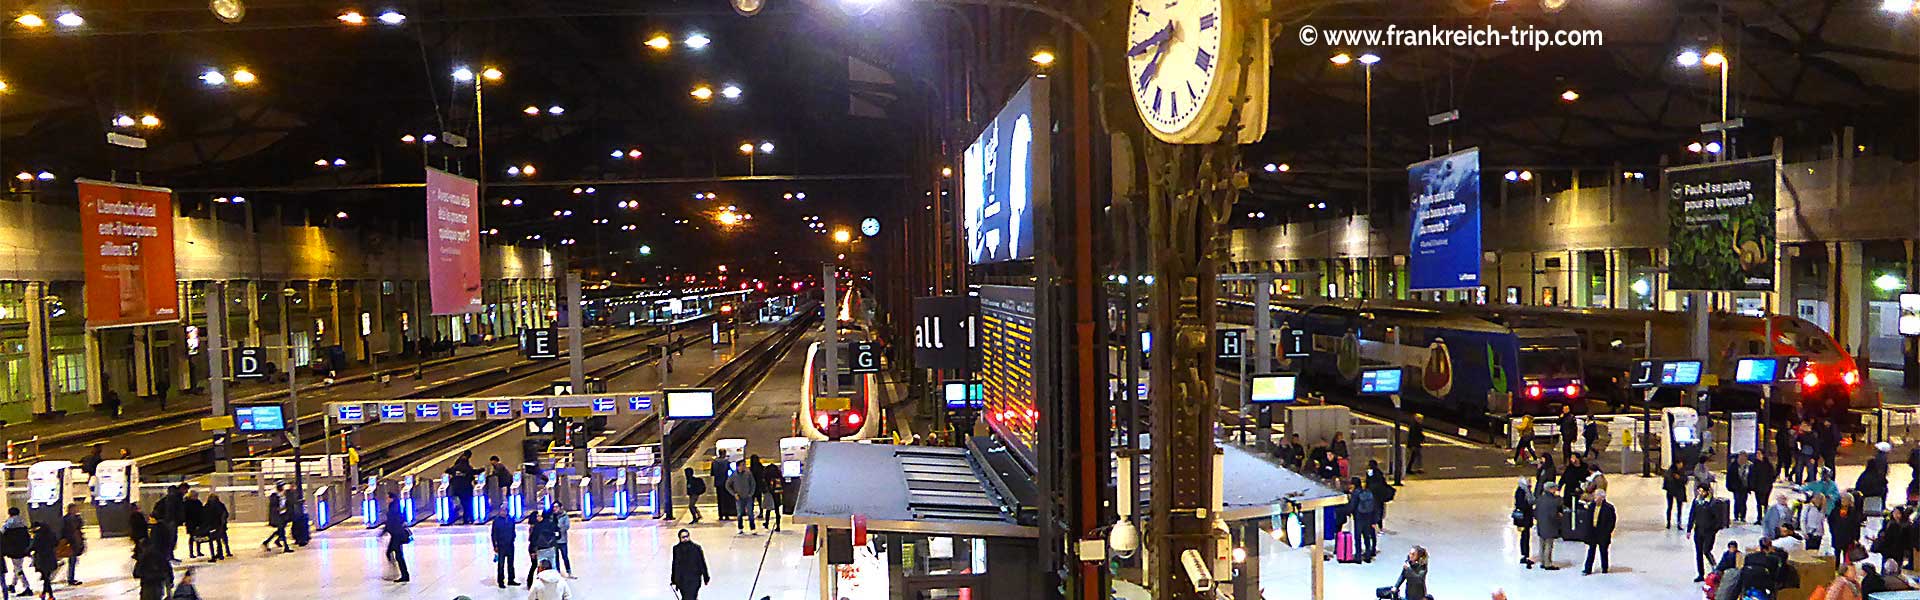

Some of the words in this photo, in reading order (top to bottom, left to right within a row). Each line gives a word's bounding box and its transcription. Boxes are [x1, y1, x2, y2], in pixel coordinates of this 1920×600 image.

[1684, 182, 1711, 195] Faut-il
[1711, 184, 1722, 193] se
[1722, 179, 1752, 194] perdre
[97, 199, 135, 216] L'endroit
[135, 201, 157, 217] idéal
[1684, 200, 1703, 212] pour
[1704, 199, 1715, 208] se
[1715, 196, 1746, 208] trouver
[98, 222, 122, 236] est-il
[123, 223, 158, 238] toujours
[100, 241, 132, 256] ailleurs
[536, 337, 549, 354] E
[1224, 337, 1238, 353] H
[242, 356, 257, 373] D
[858, 351, 873, 368] G
[1638, 367, 1651, 382] J
[1785, 363, 1798, 378] K
